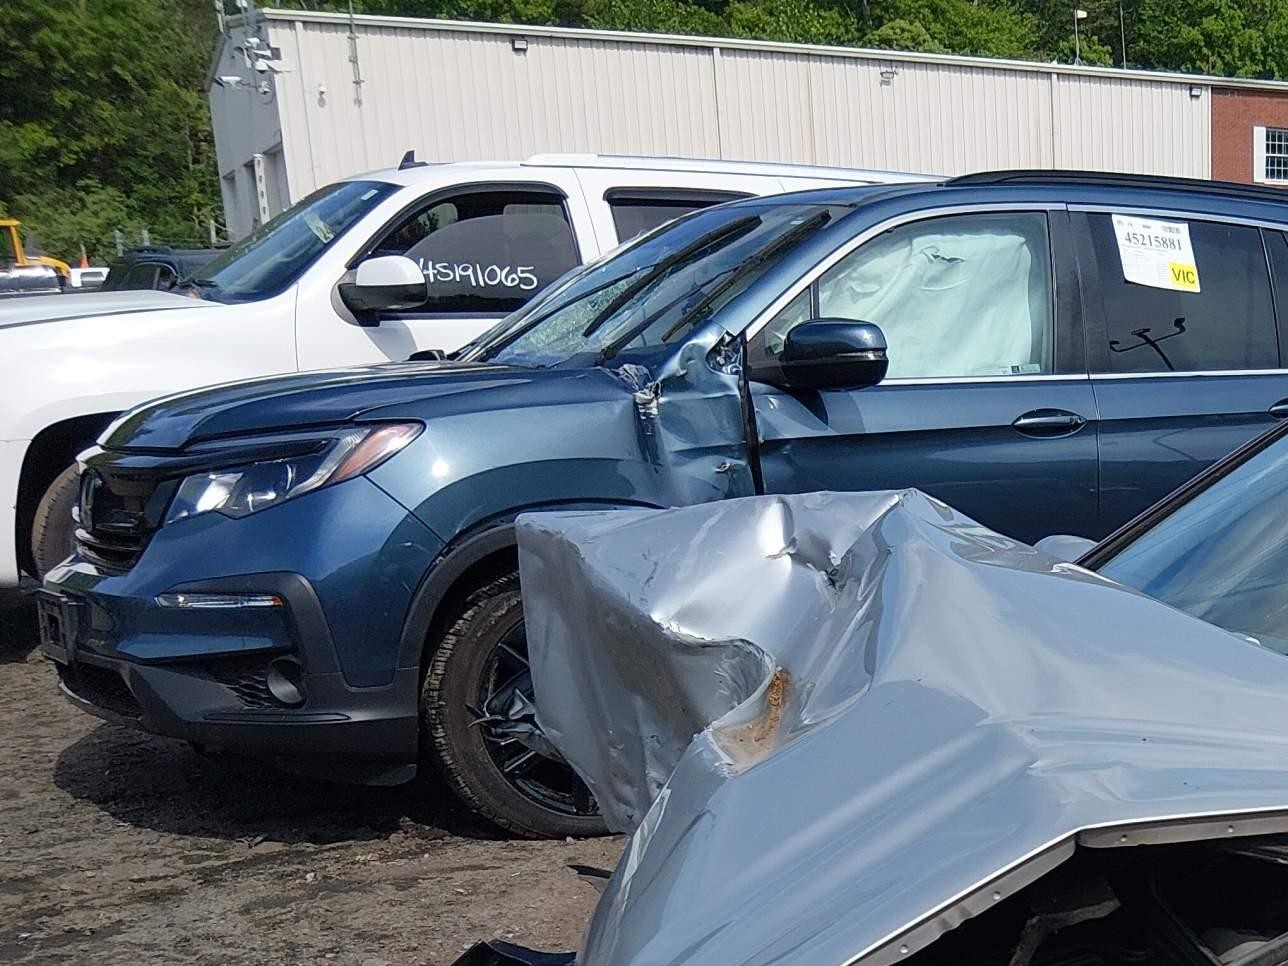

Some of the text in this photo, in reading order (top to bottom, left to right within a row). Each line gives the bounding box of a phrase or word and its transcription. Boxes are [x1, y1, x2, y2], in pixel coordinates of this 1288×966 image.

[1125, 231, 1182, 251] 45215881
[419, 258, 538, 290] 45191065
[1171, 267, 1196, 285] VIC
